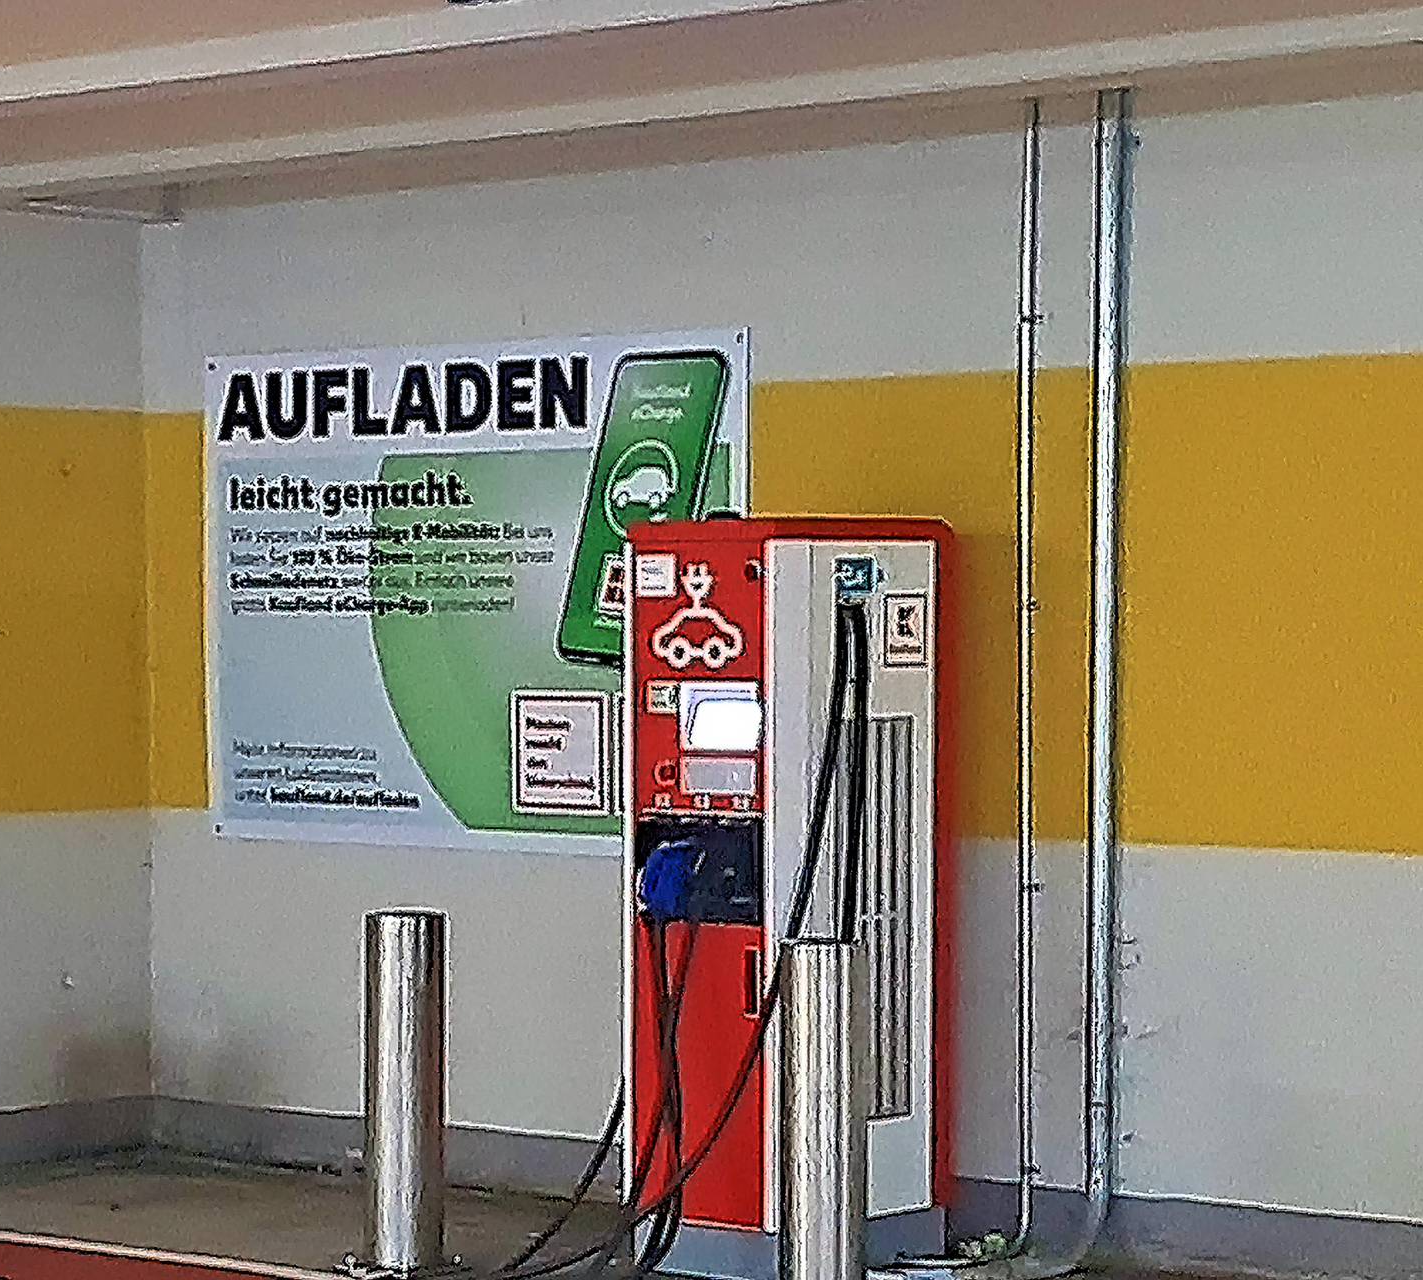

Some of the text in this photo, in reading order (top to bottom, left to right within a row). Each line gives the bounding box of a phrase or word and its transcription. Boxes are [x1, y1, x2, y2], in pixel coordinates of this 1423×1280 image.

[218, 355, 589, 441] AUFLADEN
[229, 470, 474, 518] leicht gemacht.
[317, 549, 334, 566] %
